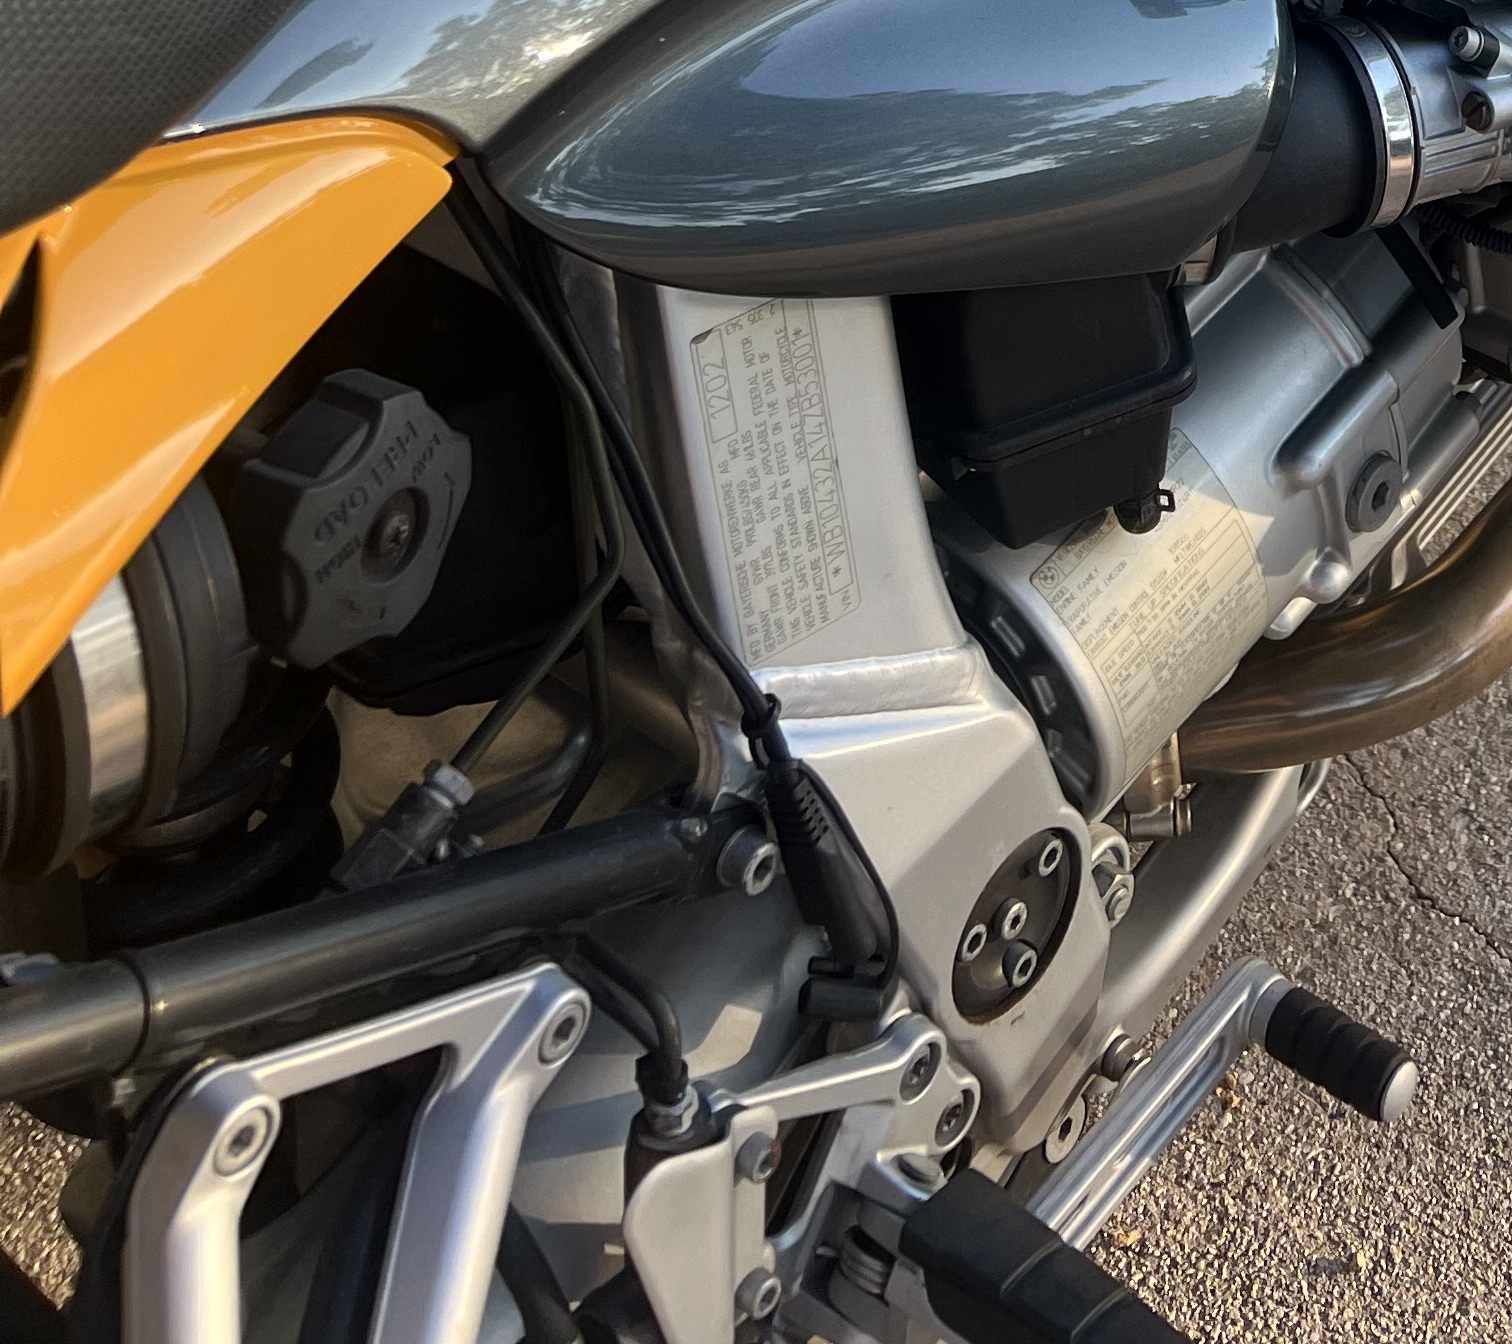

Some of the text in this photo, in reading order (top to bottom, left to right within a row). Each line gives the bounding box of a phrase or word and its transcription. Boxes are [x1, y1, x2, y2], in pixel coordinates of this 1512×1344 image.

[701, 356, 731, 419] 1202
[773, 325, 808, 463] VEHICLE TYPE MOTORCYCLE
[717, 459, 730, 474] AG
[727, 438, 740, 460] MFD
[315, 419, 419, 543] PRELOAD
[741, 335, 802, 639] THIS VEHICLE CONFORMS TO ALL APPLICABLE FEDERAL MOTOR
[746, 464, 760, 492] REAR
[758, 351, 816, 630] VEHICLE SAFETY STANDARDS IN EFFECT ON THE DATE OF
[720, 479, 744, 557] MOTORENWERKE
[751, 494, 766, 523] GAWR
[797, 485, 831, 624] MANUFACTURE SHOWN ABOVE
[734, 559, 754, 618] BAYERISCHE
[766, 583, 781, 613] FRONT
[838, 588, 853, 611] VIN
[745, 622, 758, 636] BY
[758, 608, 776, 653] GERMANY
